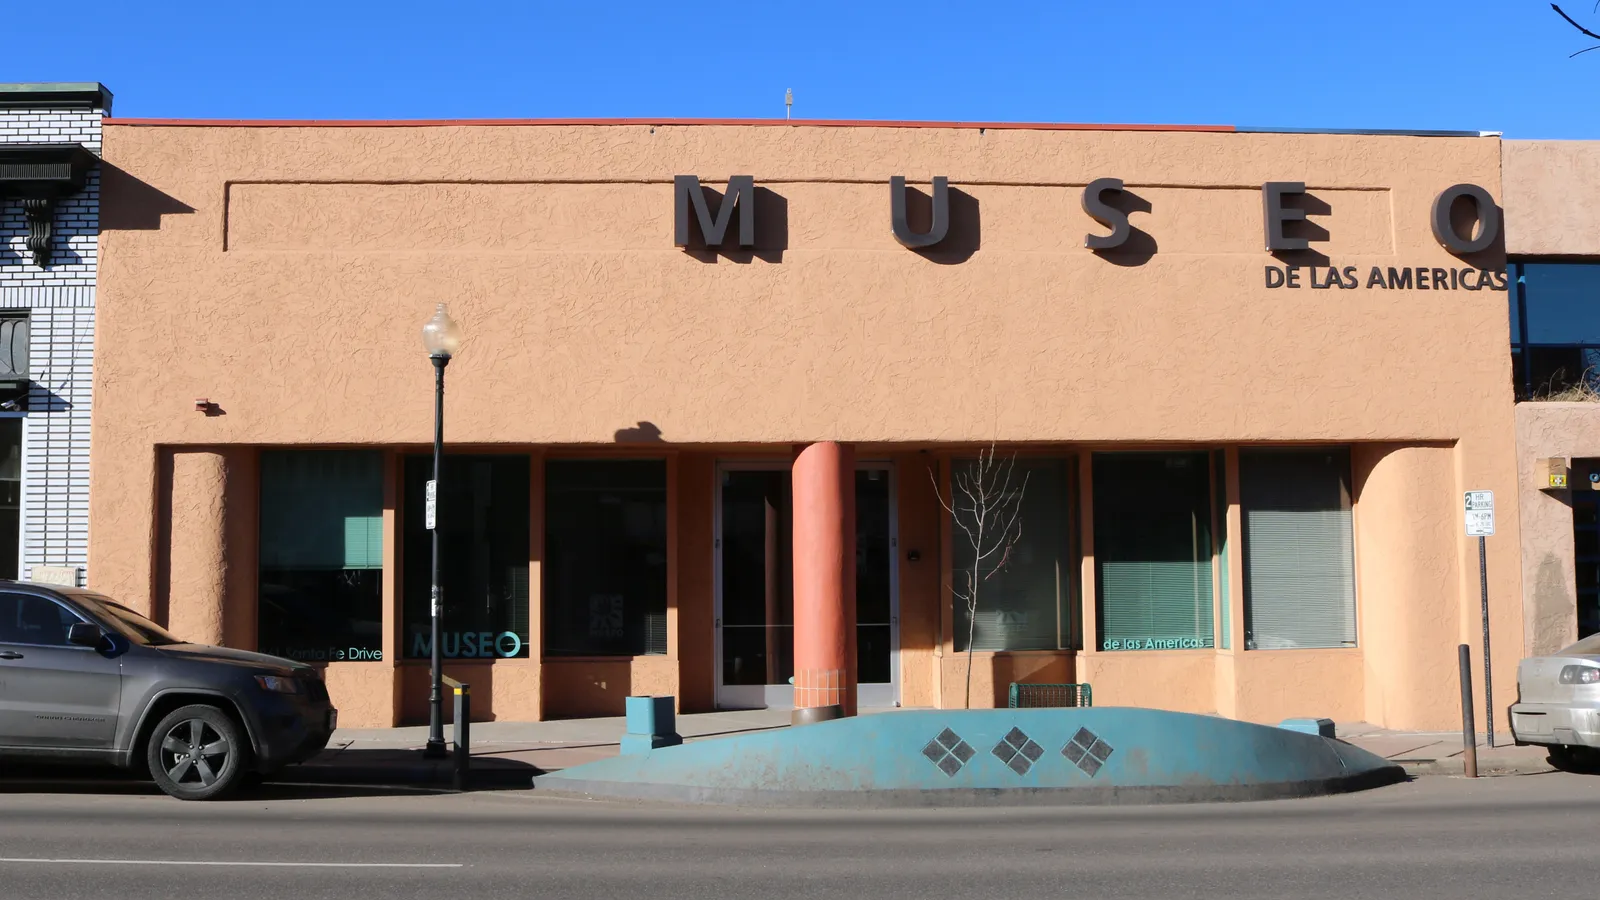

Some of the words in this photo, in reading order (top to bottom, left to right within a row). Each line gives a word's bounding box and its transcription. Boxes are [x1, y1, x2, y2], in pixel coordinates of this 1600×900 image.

[674, 174, 1499, 254] MUSEO
[1265, 265, 1301, 289] DE
[1310, 266, 1358, 290] LAS
[1366, 267, 1508, 291] AMERICAS
[1465, 495, 1472, 508] 2
[413, 631, 521, 658] MUSEO
[1103, 639, 1120, 650] de
[1123, 638, 1141, 650] las
[1144, 637, 1204, 649] Americas
[285, 647, 325, 660] Santa
[329, 647, 345, 660] Fe
[348, 647, 383, 660] Drive
